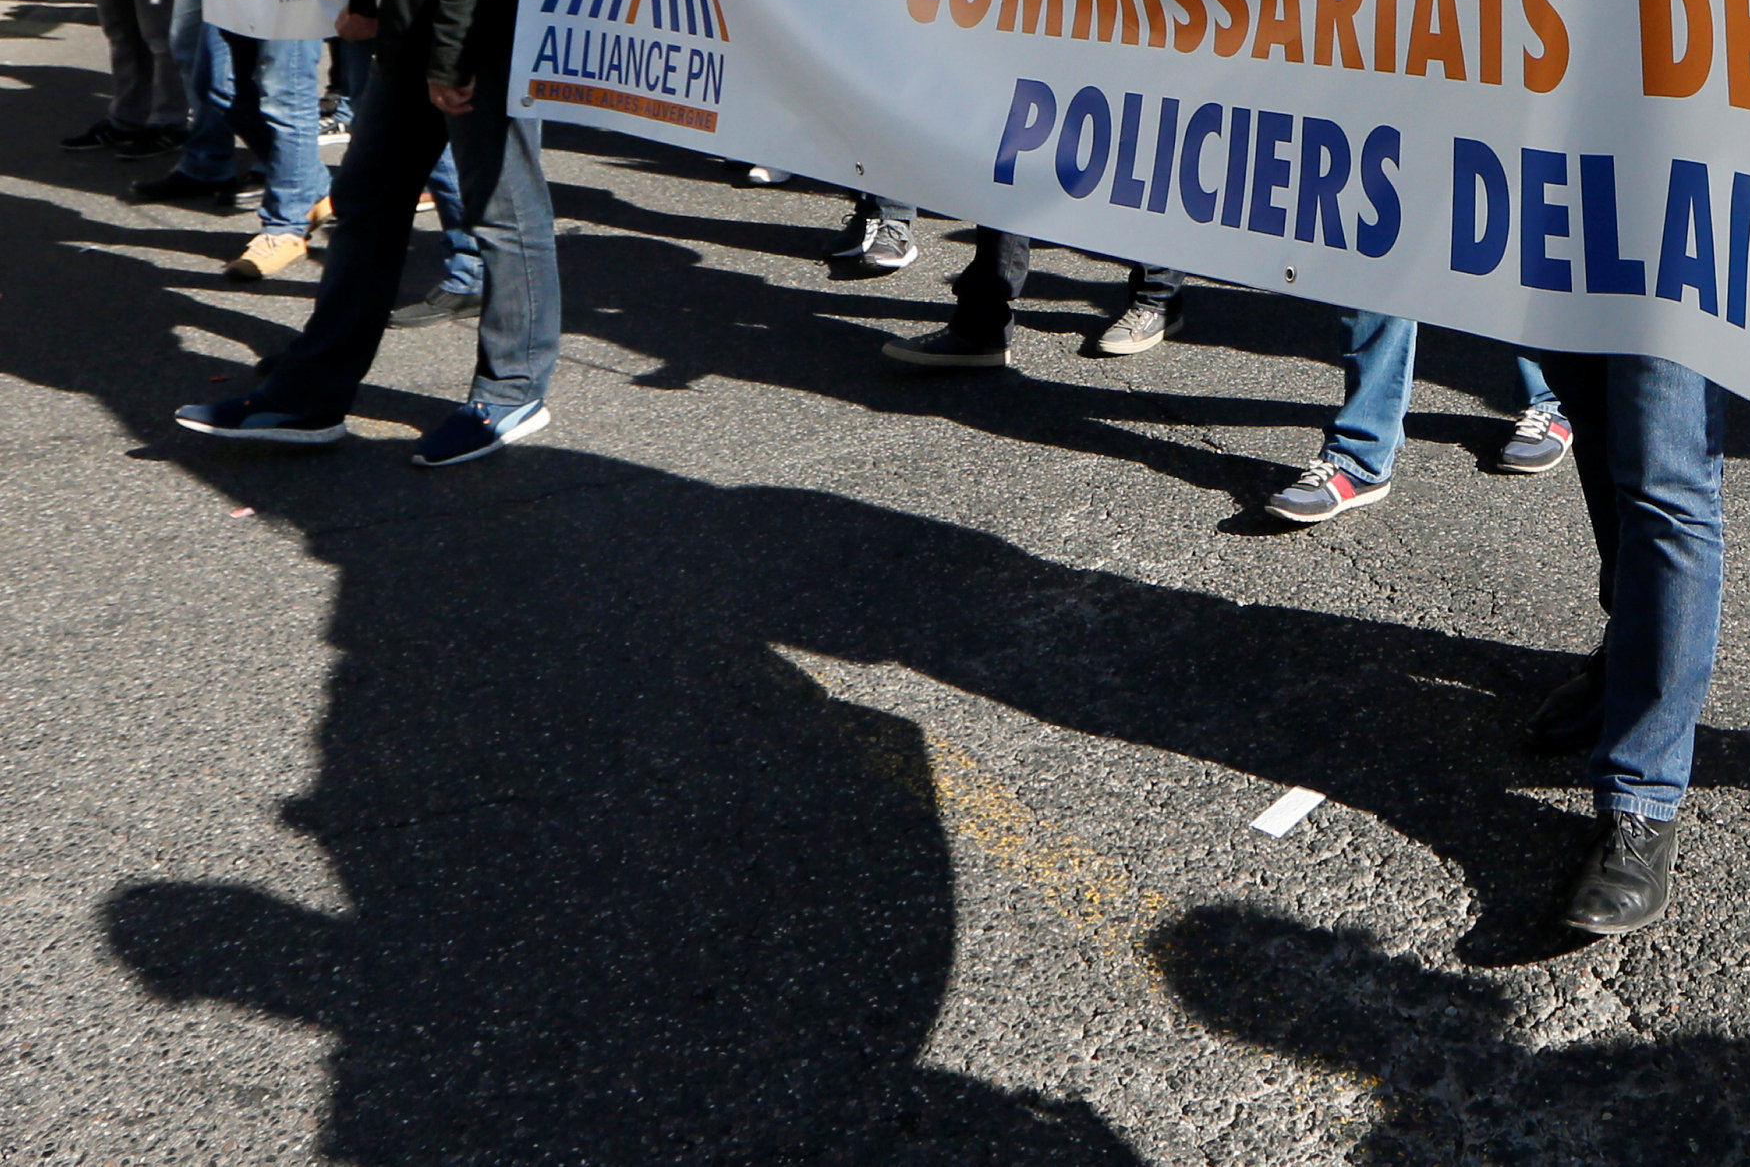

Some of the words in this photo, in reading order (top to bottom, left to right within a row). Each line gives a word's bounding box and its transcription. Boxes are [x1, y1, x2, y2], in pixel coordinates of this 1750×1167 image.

[531, 25, 681, 95] ALLIANCE
[685, 48, 724, 105] PN
[994, 78, 1402, 257] POLICIERS
